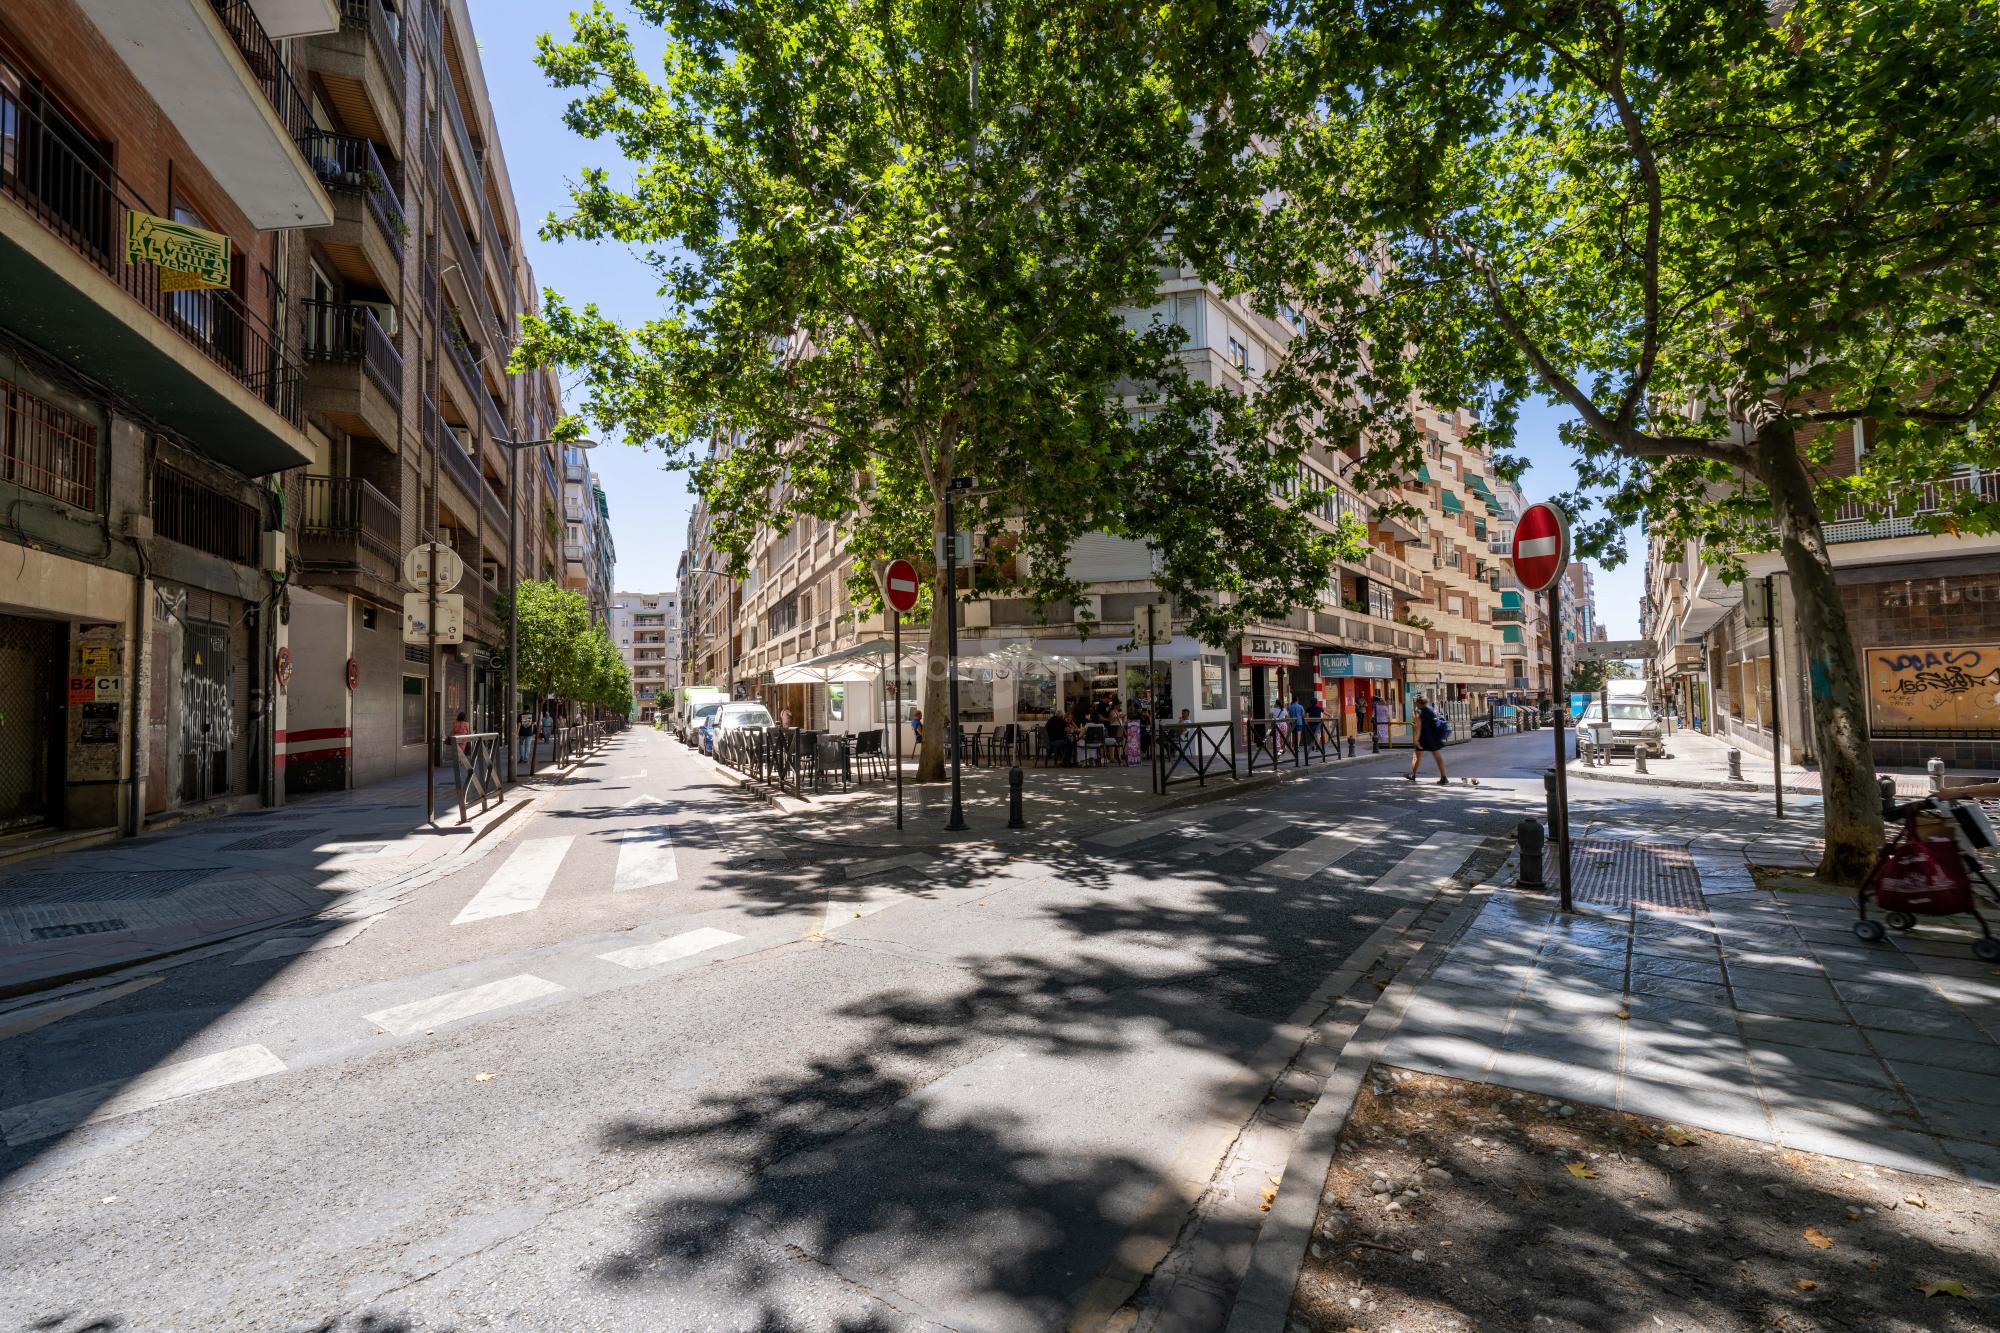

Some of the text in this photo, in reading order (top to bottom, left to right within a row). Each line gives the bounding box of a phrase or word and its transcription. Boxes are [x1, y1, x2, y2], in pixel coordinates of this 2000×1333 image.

[1252, 640, 1270, 653] EL
[71, 679, 94, 690] B2
[98, 678, 119, 690] C1
